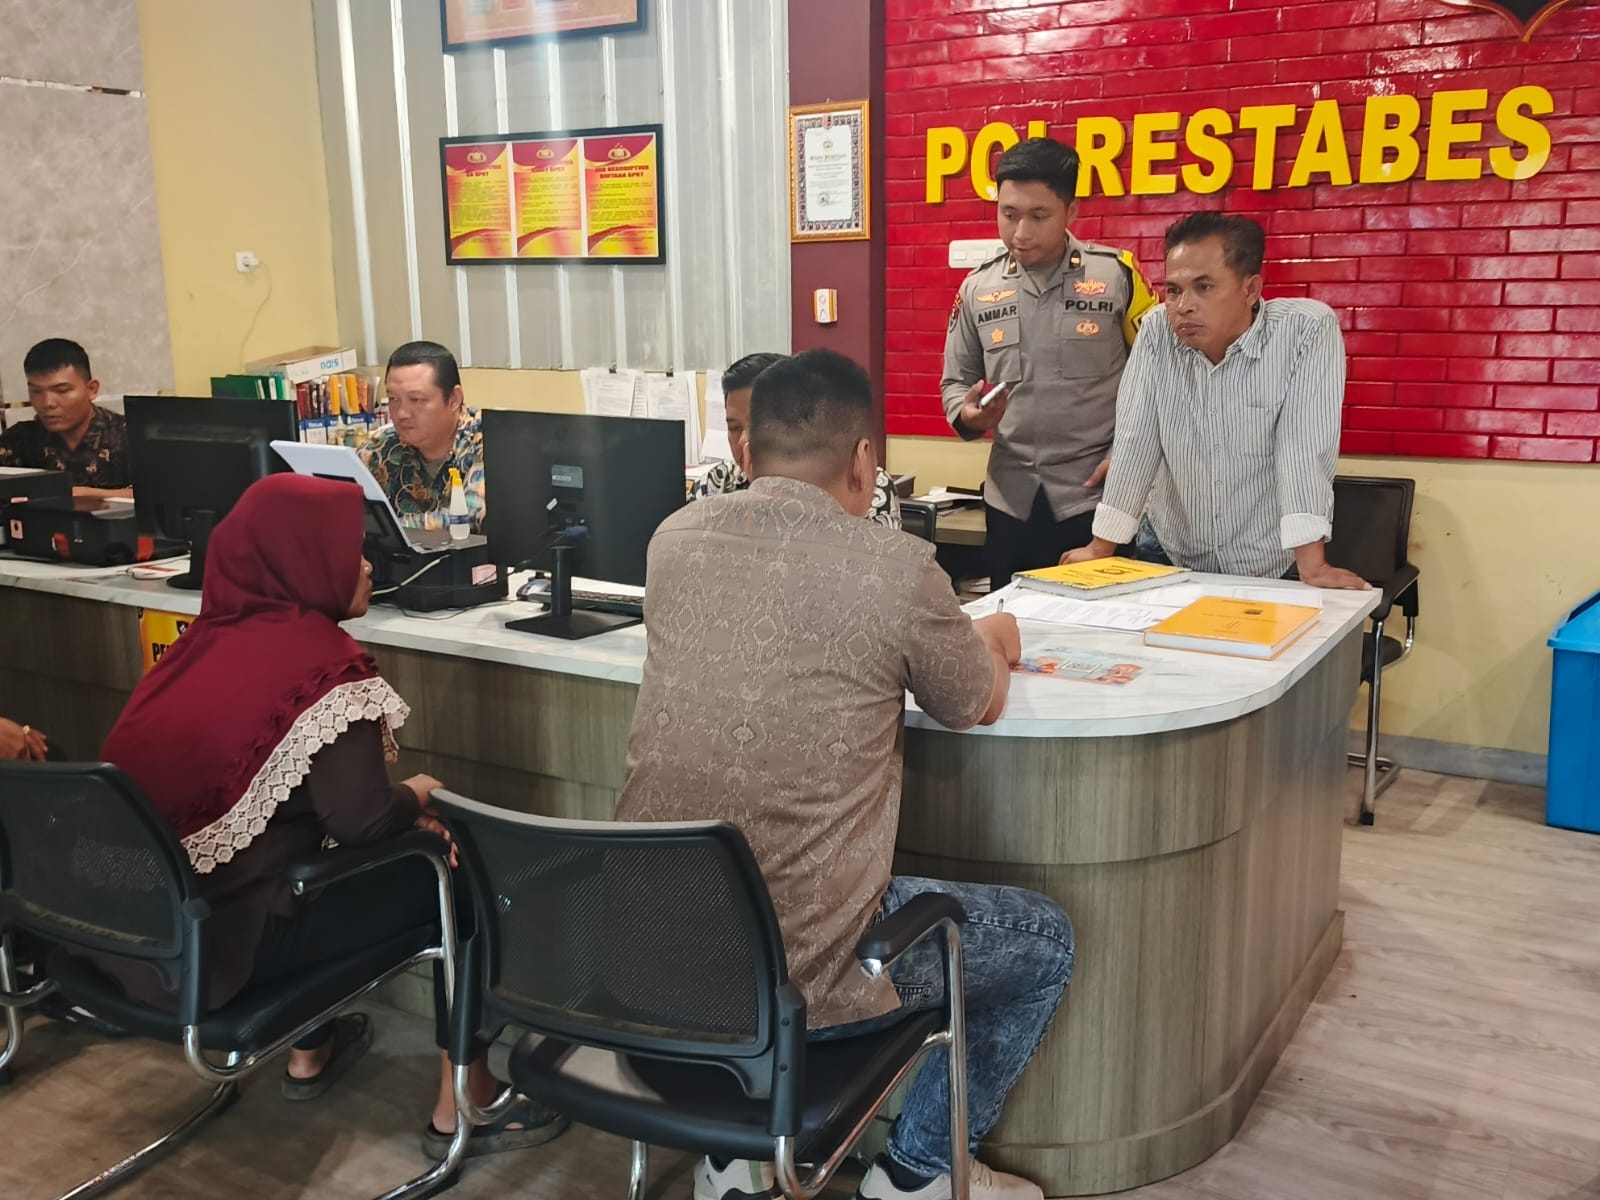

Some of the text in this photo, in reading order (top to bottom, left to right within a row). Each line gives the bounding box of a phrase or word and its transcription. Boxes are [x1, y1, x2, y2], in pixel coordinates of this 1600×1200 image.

[926, 85, 1555, 203] PORESTABES
[977, 305, 1018, 324] AMMAR
[1065, 300, 1113, 312] POLRI
